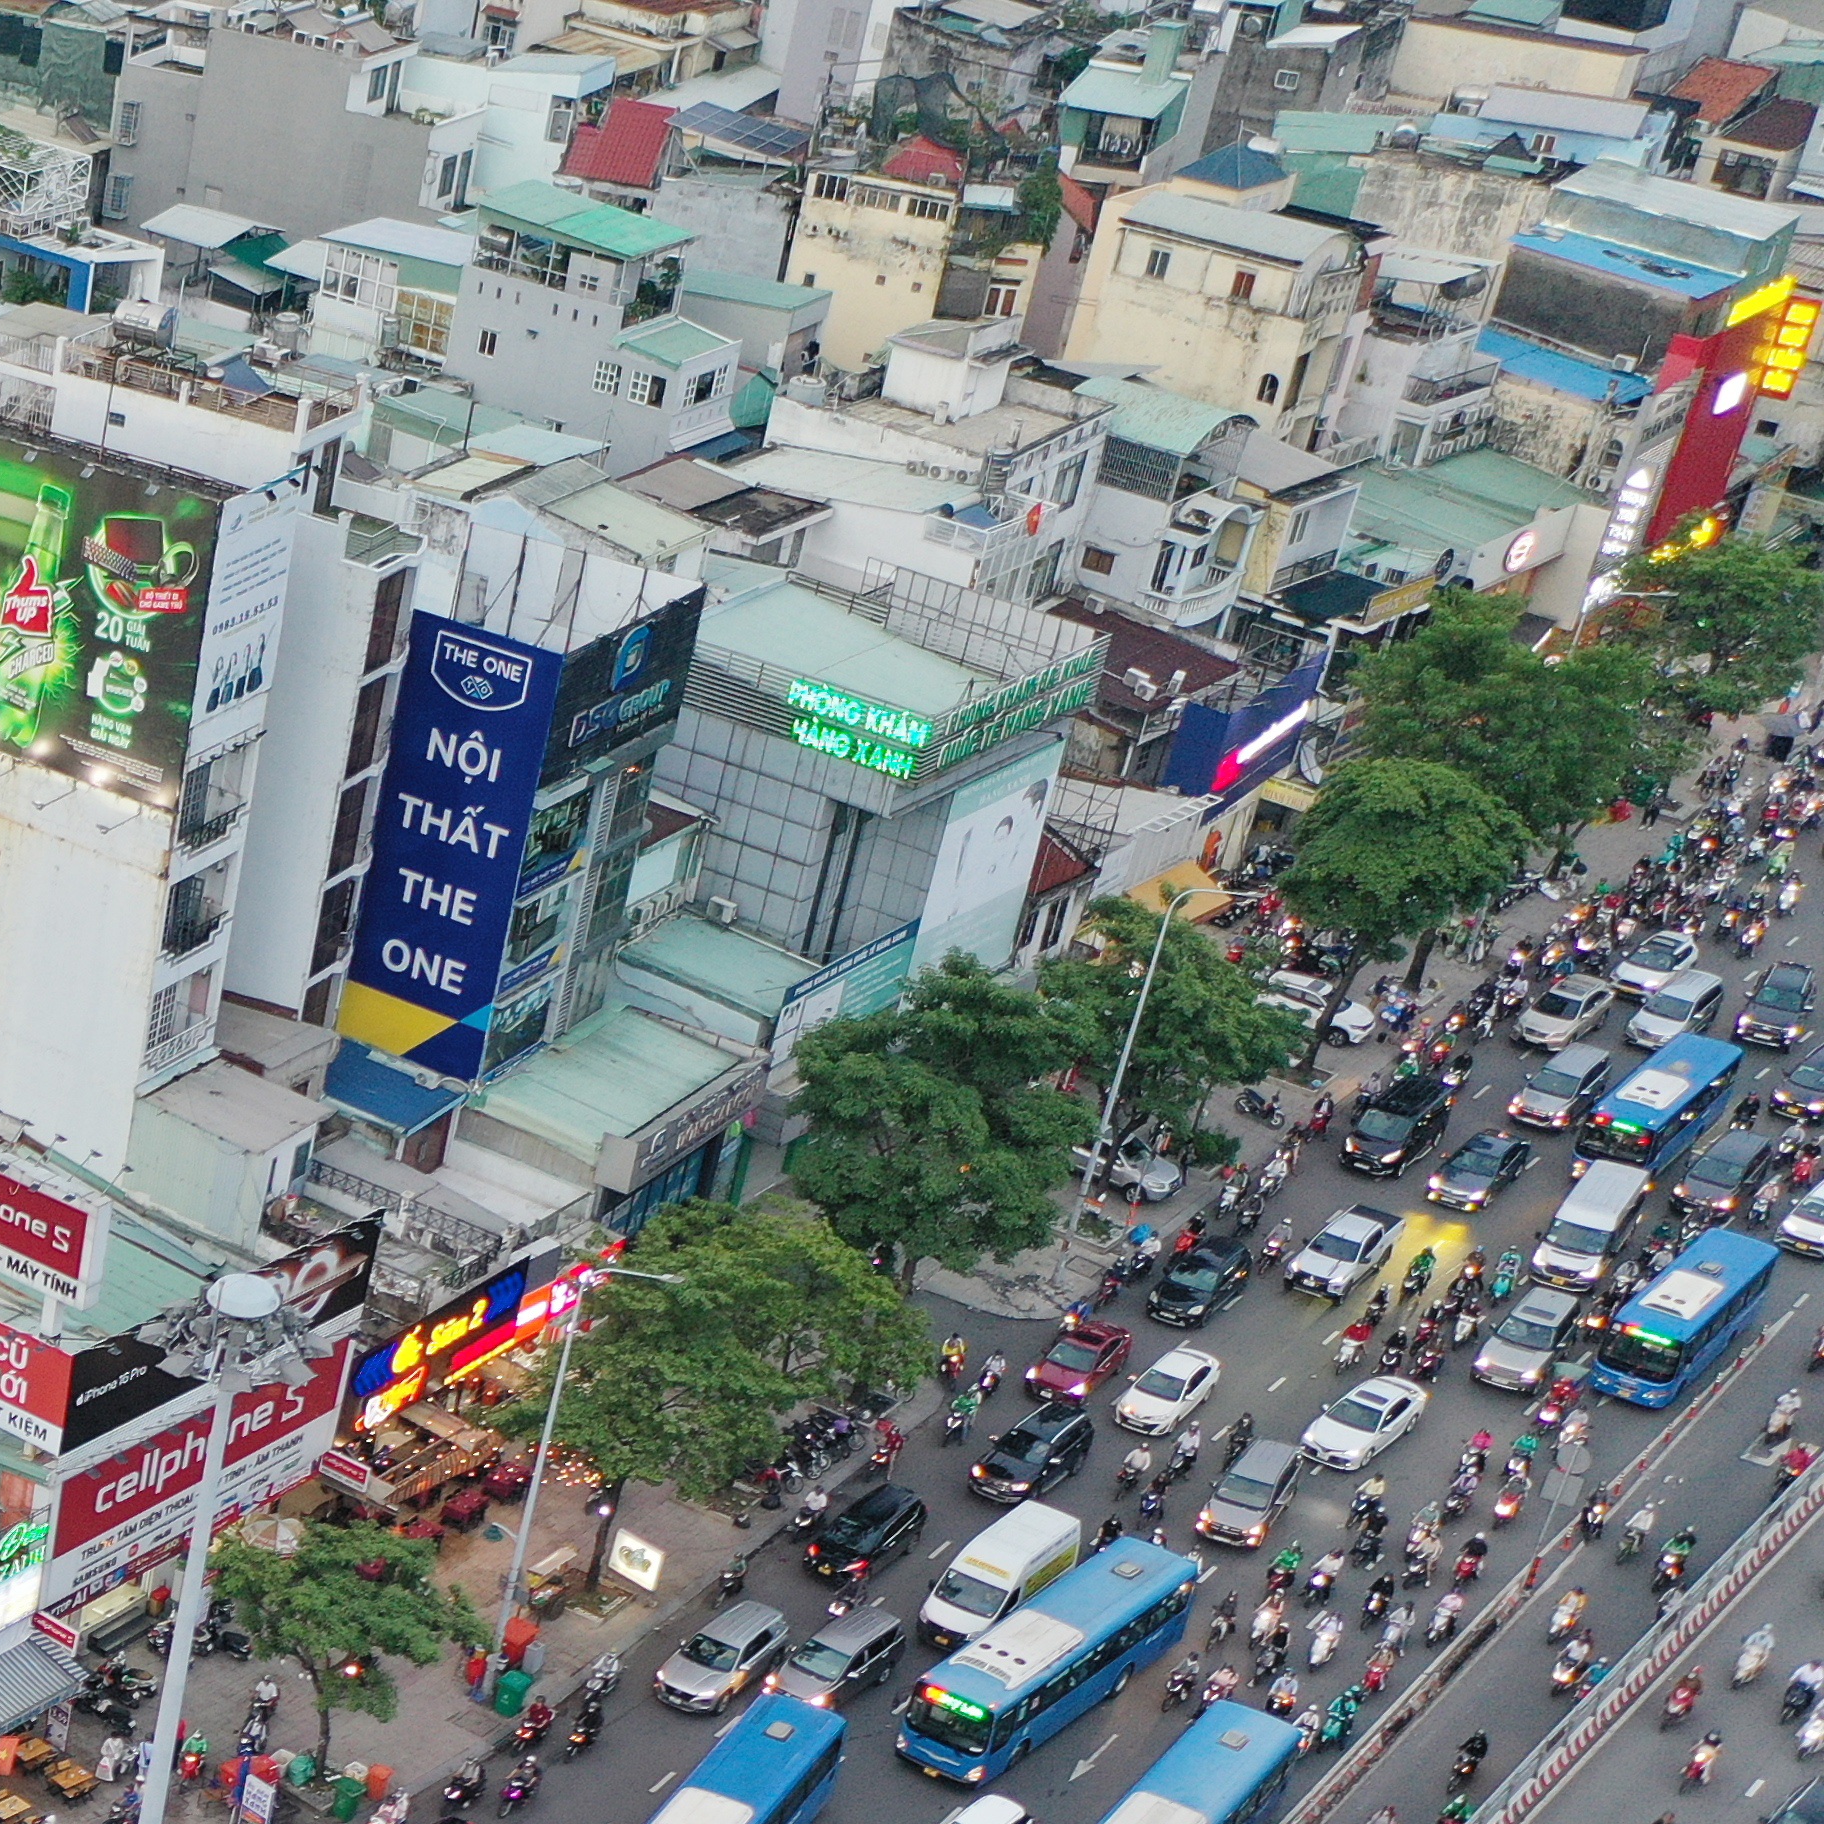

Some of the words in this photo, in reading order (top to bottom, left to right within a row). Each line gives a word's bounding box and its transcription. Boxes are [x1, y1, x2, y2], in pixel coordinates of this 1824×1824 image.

[4, 594, 49, 614] Thums
[139, 600, 151, 609] CHO
[152, 600, 170, 610] GAME
[155, 590, 172, 601] THIẾT
[95, 611, 124, 643] 20
[126, 620, 147, 635] GIẢI
[126, 632, 151, 653] TUẦN
[443, 642, 479, 670] THE
[483, 655, 525, 684] ONE
[619, 678, 671, 722] GROUP
[786, 678, 862, 728] PHÒNG
[864, 705, 934, 748] KHÁM
[1045, 678, 1092, 721] XANH
[91, 713, 114, 729] HÀNG
[426, 727, 502, 785] NỘI
[791, 715, 853, 759] HÀNG
[852, 738, 914, 780] XANH
[398, 792, 510, 860] THẤT
[398, 867, 478, 926] THE
[381, 939, 468, 996] ONE
[6, 1253, 40, 1283] MÁY
[42, 1271, 78, 1300] TÍNH
[83, 1381, 117, 1403] iPhone
[117, 1372, 130, 1390] 16
[130, 1364, 148, 1382] Pro
[8, 1413, 49, 1443] KIỆM
[272, 1433, 304, 1457] THANH
[95, 1400, 274, 1514] cellphne
[117, 1522, 139, 1542] TÂM
[139, 1509, 163, 1530] ĐIỆN
[164, 1493, 194, 1517] THOẠI
[72, 1557, 118, 1588] SAMSUNG
